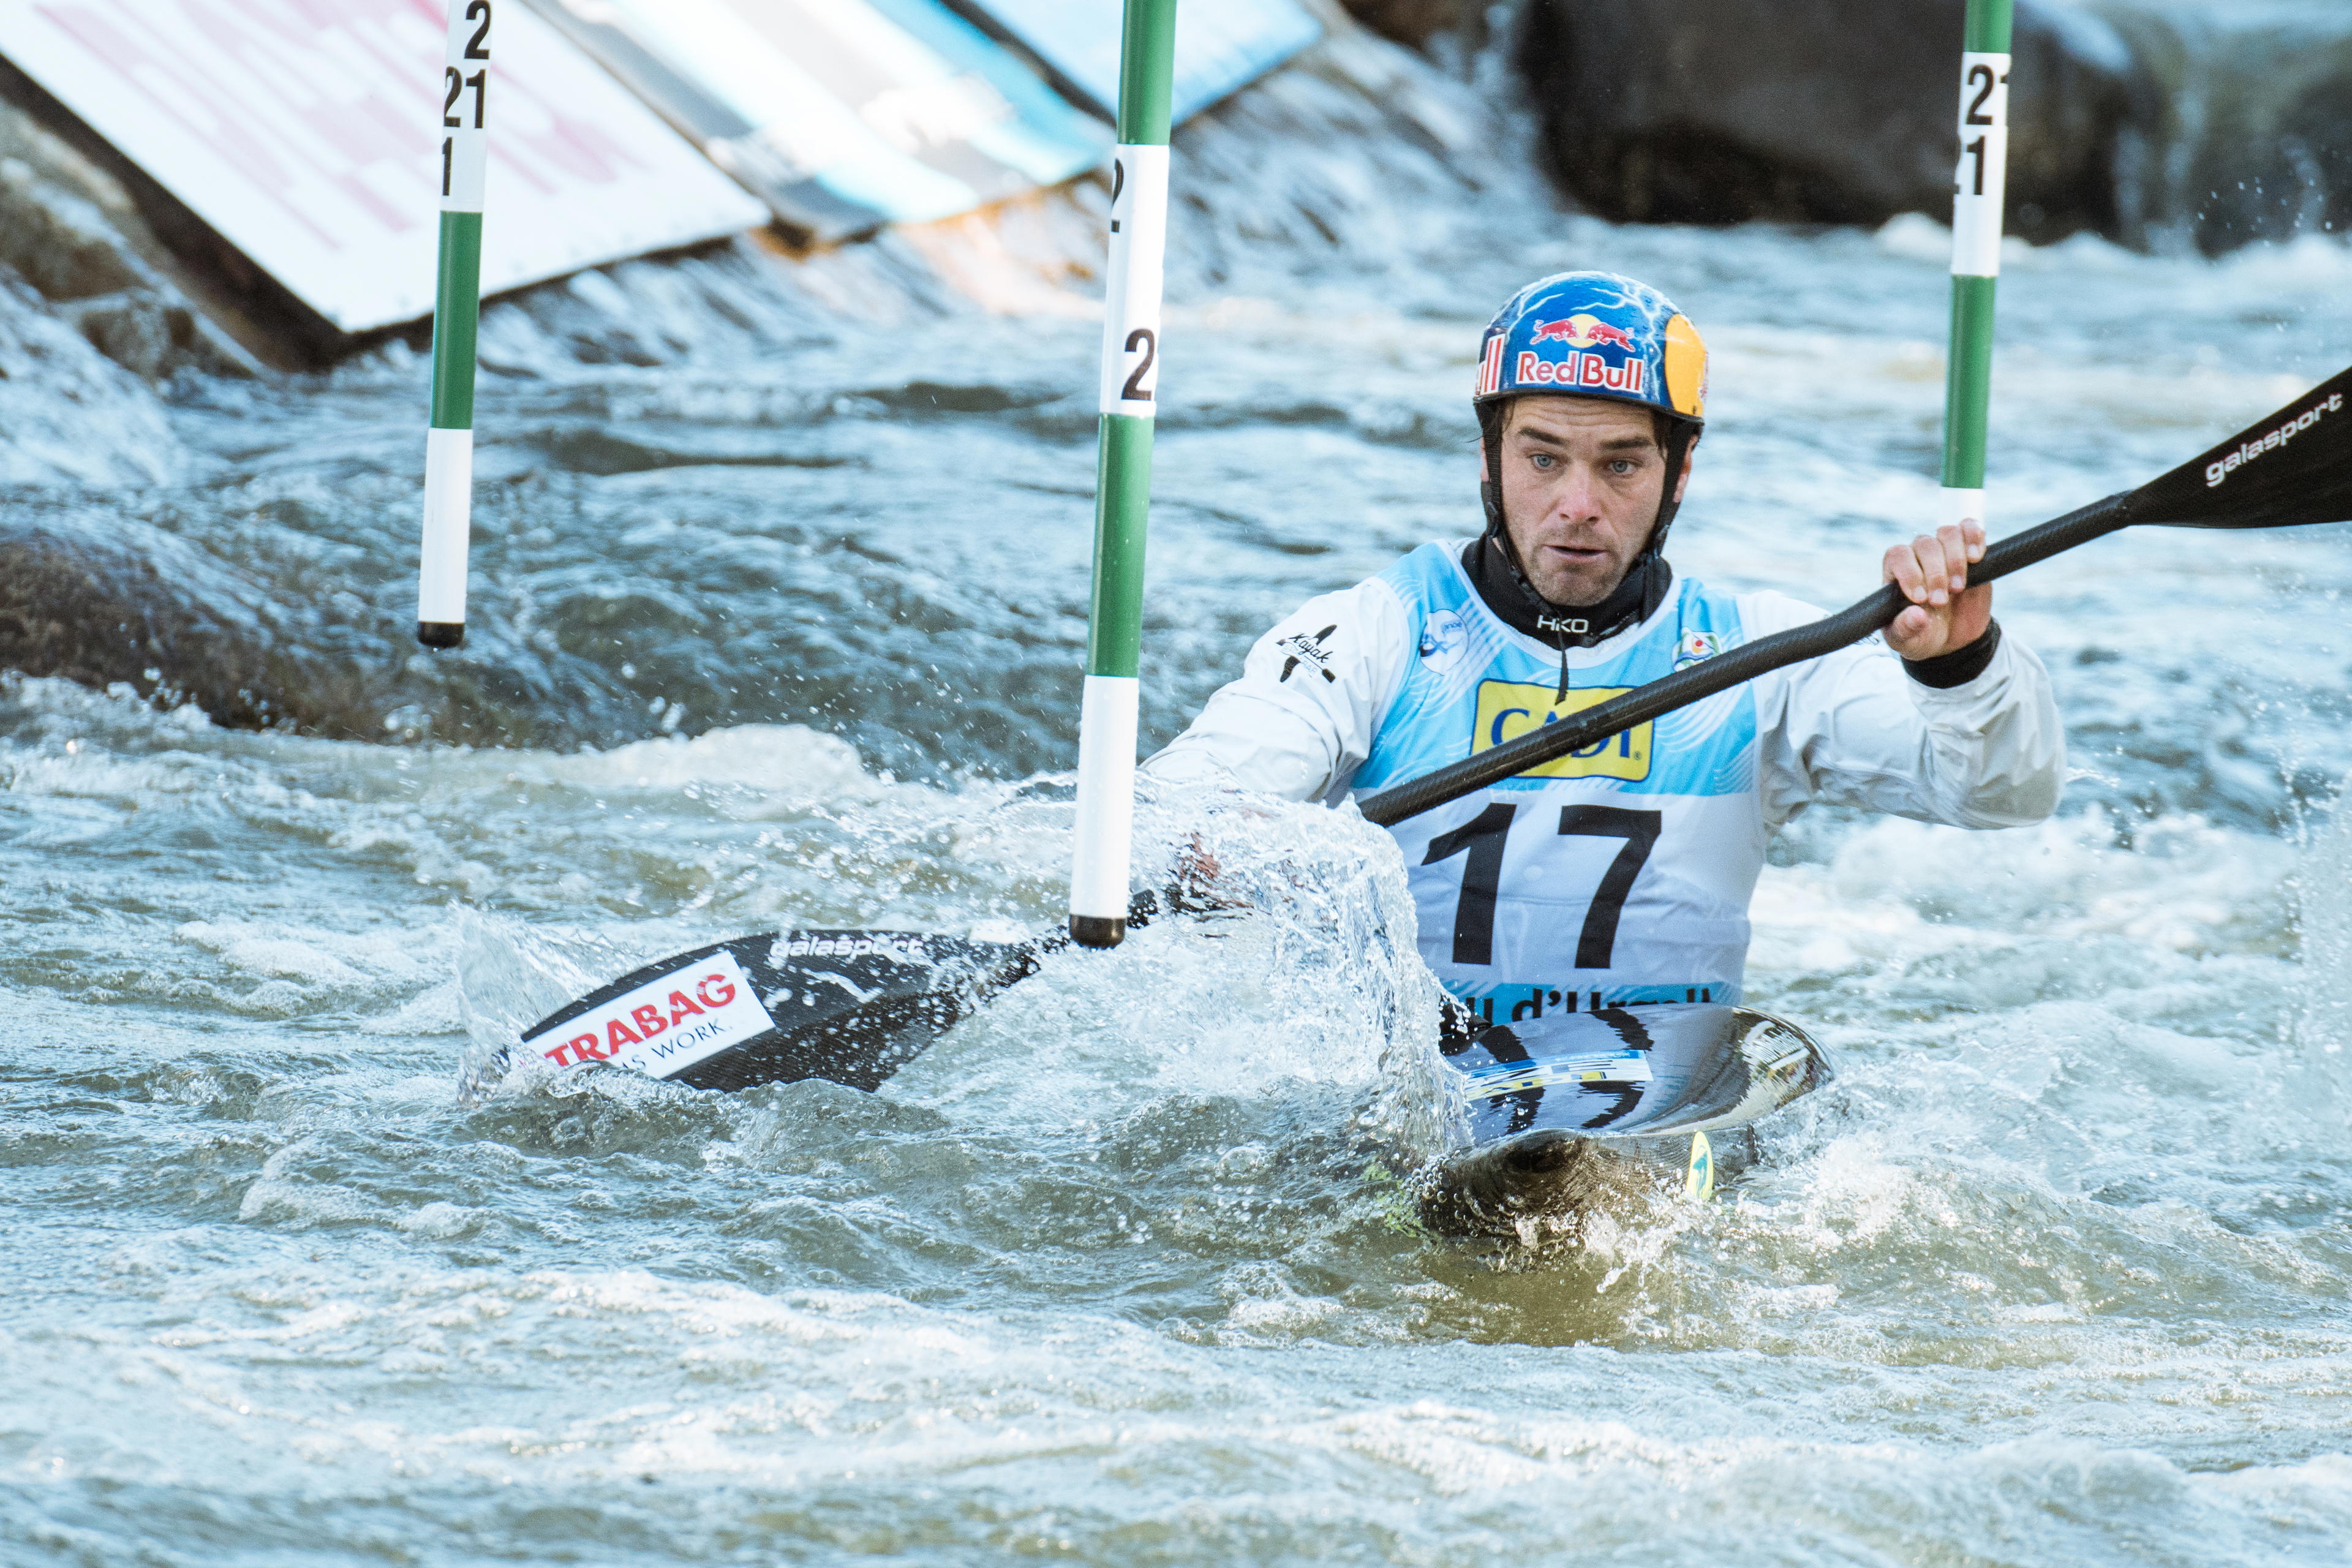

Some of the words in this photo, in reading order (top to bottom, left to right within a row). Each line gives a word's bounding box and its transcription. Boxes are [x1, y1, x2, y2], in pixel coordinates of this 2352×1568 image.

[464, 0, 491, 59] 2
[1121, 328, 1155, 400] 2
[1518, 352, 1577, 383] Red
[1583, 355, 1642, 391] Bull
[2206, 393, 2342, 488] galasport
[1288, 633, 1333, 663] Kayak
[1421, 802, 1662, 969] 17
[543, 973, 736, 1067] TRABAG
[651, 1017, 733, 1059] WORK.
